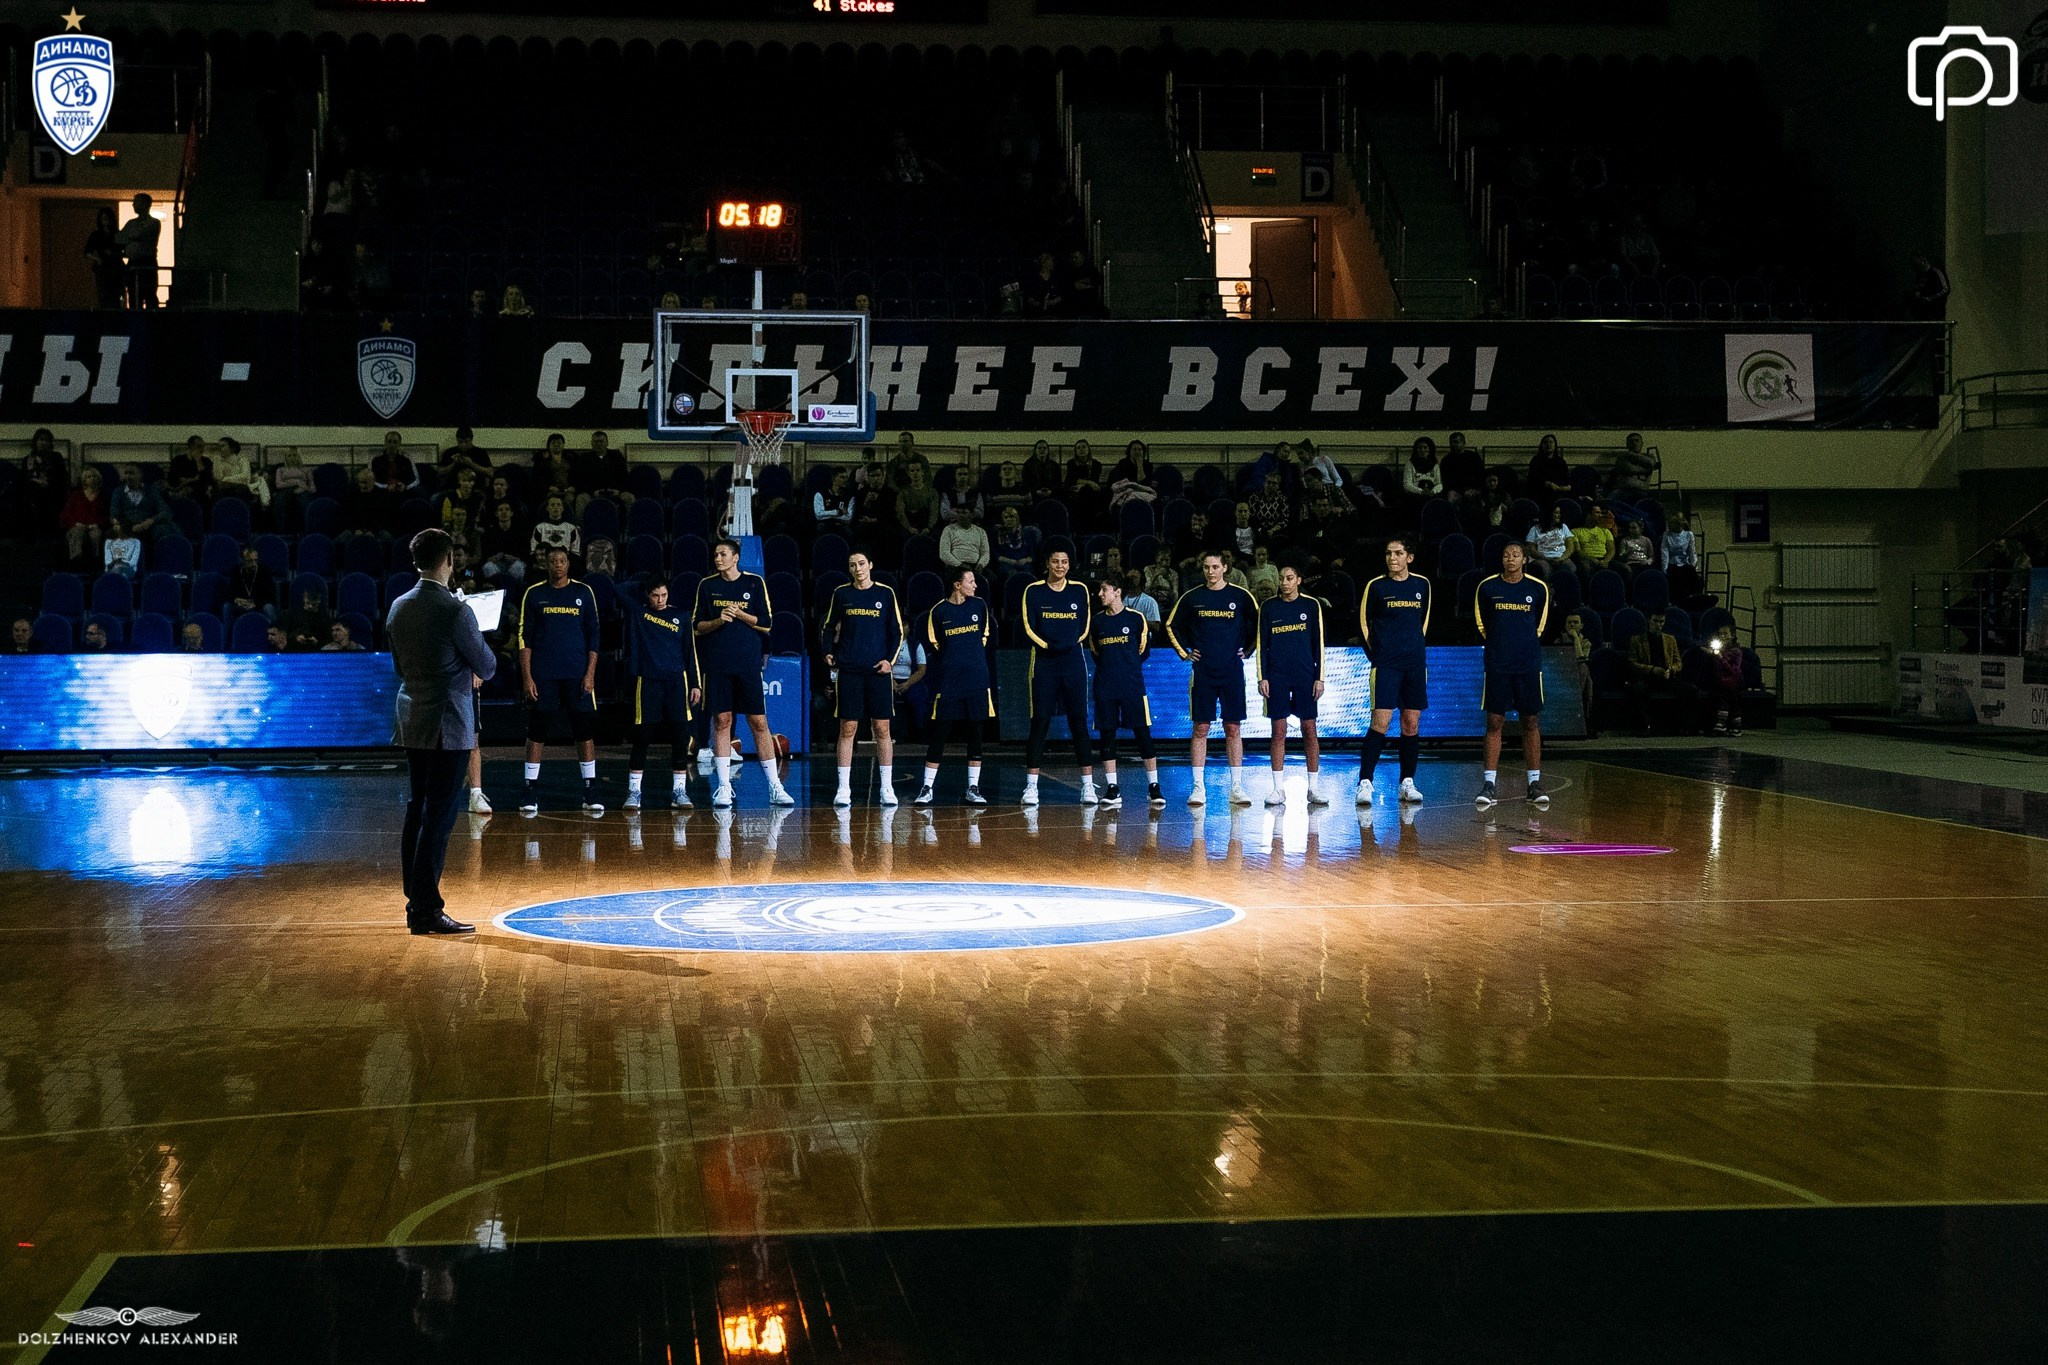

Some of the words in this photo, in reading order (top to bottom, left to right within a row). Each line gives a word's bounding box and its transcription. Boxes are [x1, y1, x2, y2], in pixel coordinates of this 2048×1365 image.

[813, 0, 832, 12] 41
[840, 0, 895, 13] Stokes
[33, 145, 63, 180] D
[1304, 166, 1331, 197] D
[362, 341, 411, 355] ДИНАМО
[537, 341, 1083, 412] СИЛЬНЕЕ
[1161, 346, 1499, 412] ВСЕХ!
[1739, 504, 1764, 539] F
[1386, 600, 1422, 609] FENERBAHÇE
[1495, 602, 1532, 612] FENERBAHÇE
[543, 607, 580, 616] FENERBAHÇE
[1042, 611, 1078, 620] FENERBAHÇE
[1198, 610, 1235, 619] FENERBAHÇE
[643, 612, 680, 633] FENERBAHÇE
[1271, 623, 1307, 635] FENERBAHÇE
[944, 624, 979, 637] FENERBAHÇE
